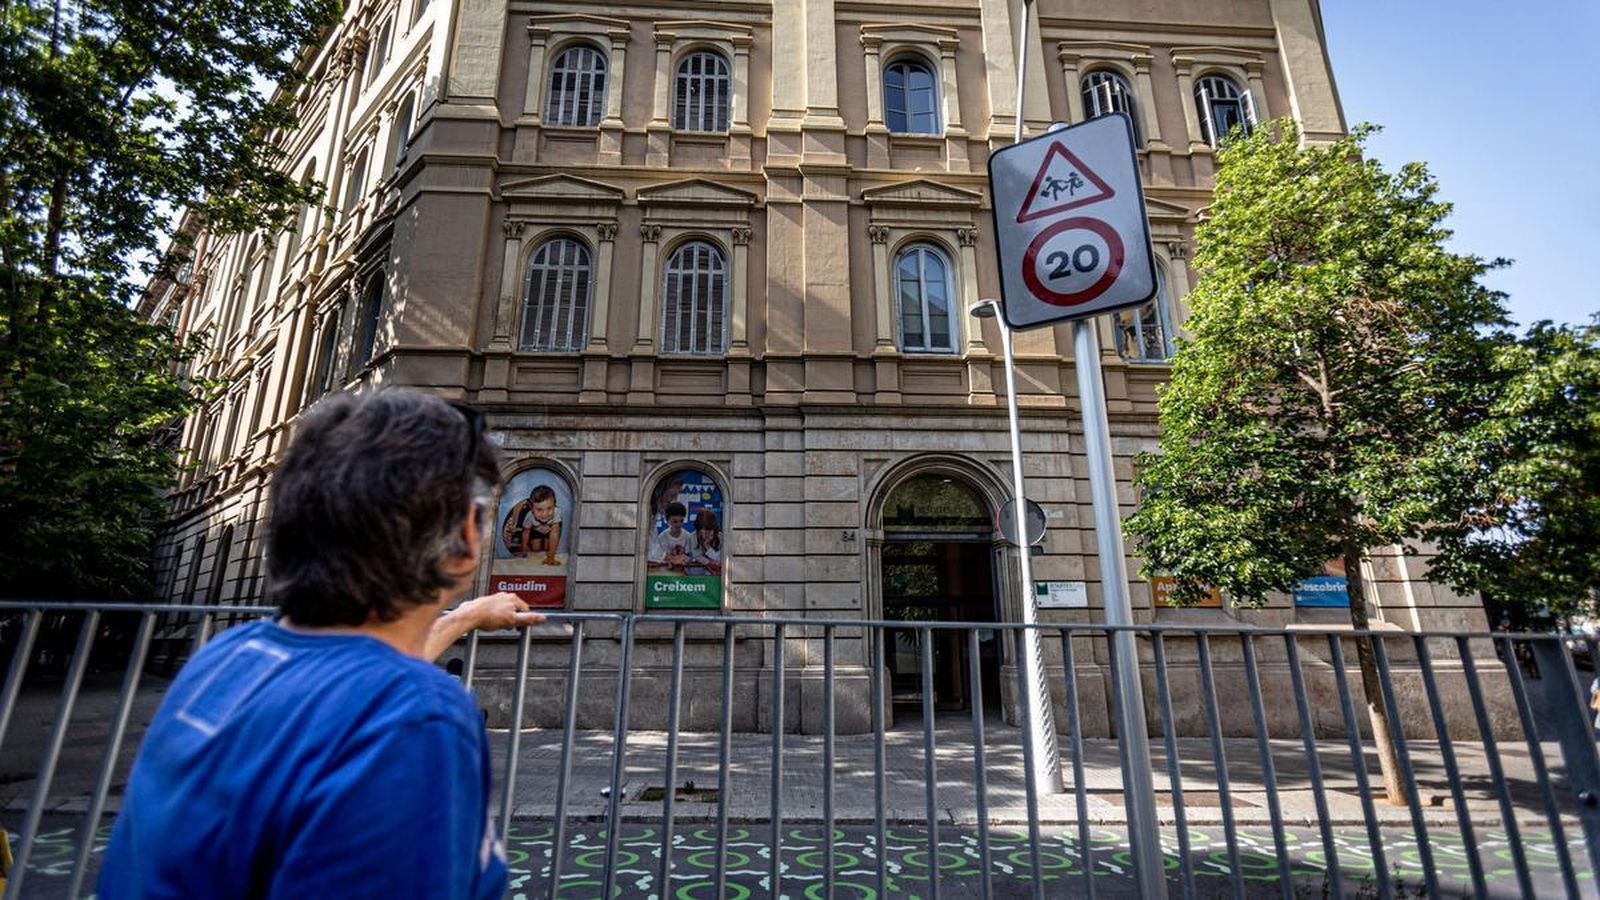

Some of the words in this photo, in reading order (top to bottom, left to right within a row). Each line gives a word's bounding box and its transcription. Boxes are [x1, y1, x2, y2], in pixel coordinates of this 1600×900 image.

[1046, 244, 1099, 280] 20
[497, 581, 547, 591] Gaudim
[654, 581, 706, 592] Creixem
